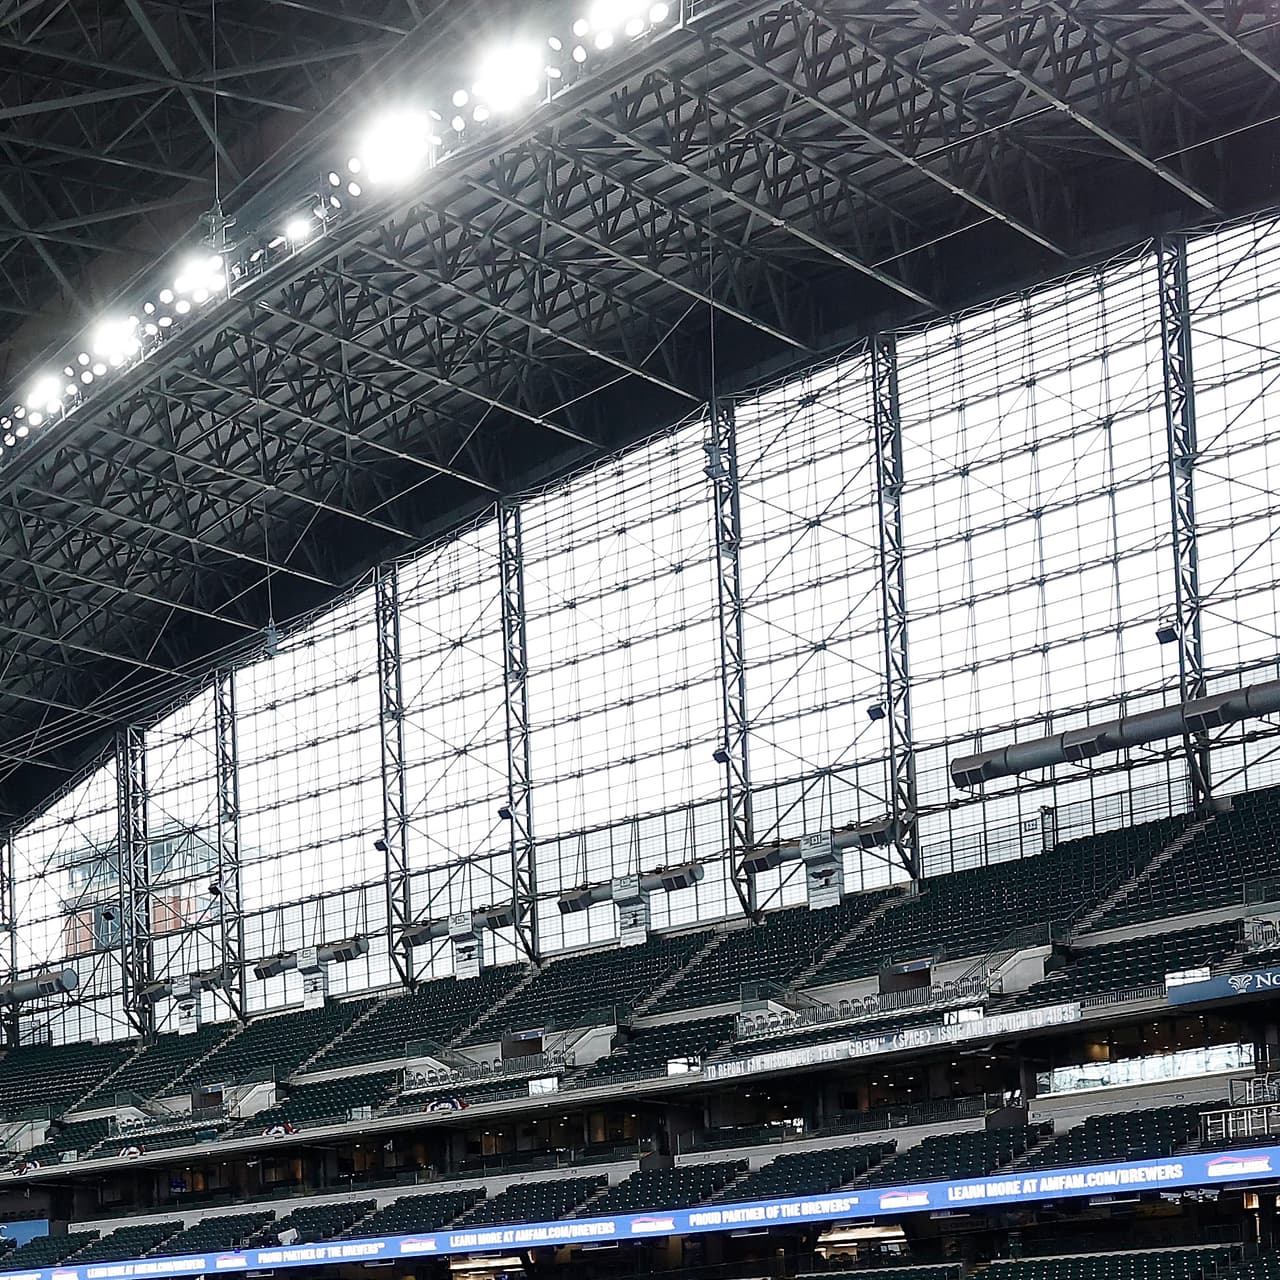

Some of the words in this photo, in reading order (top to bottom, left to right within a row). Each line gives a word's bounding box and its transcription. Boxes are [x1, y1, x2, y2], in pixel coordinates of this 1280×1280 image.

[948, 1183, 986, 1202] LEARN
[986, 1180, 1020, 1198] MORE
[1022, 1178, 1038, 1194] AT
[688, 1211, 720, 1226] PROUD
[721, 1206, 766, 1223] PARTNER
[766, 1205, 779, 1219] OF
[780, 1203, 800, 1217] THE
[450, 1233, 476, 1248] LEARN
[476, 1231, 502, 1245] MORE
[502, 1230, 514, 1243] AT
